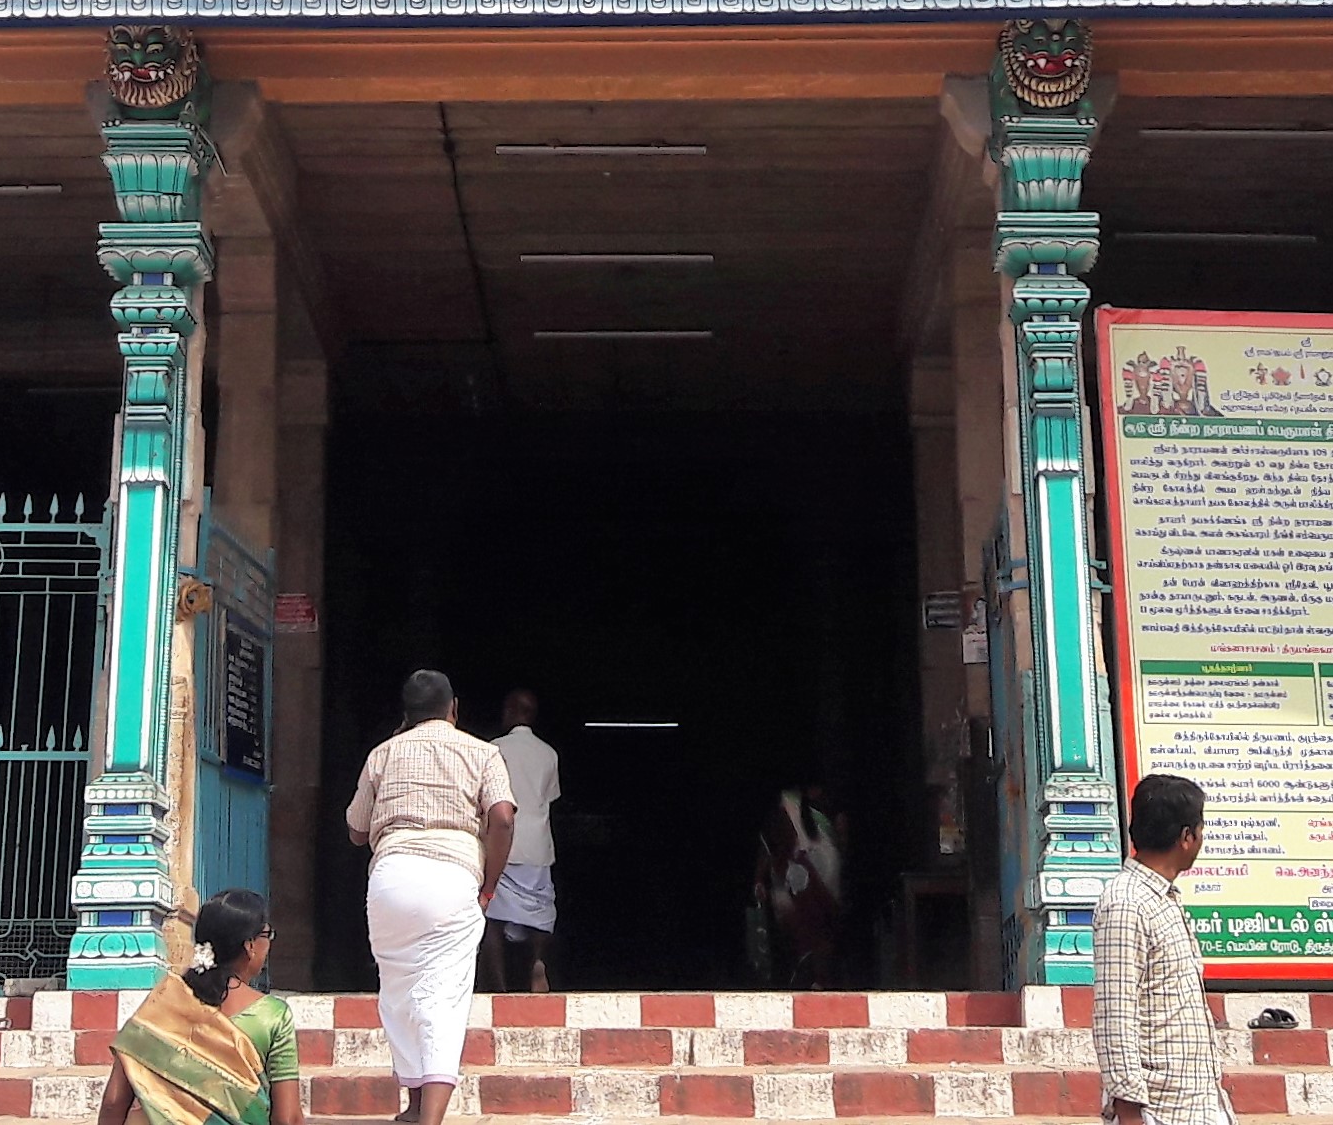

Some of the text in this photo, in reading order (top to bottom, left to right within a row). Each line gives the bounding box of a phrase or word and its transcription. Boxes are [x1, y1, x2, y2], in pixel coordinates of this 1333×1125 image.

[1147, 418, 1166, 437] ஸ்ரீ
[1169, 419, 1201, 437] நின்ற
[1228, 911, 1310, 937] டிஜிட்டல்
[1226, 939, 1267, 952] மெயின்
